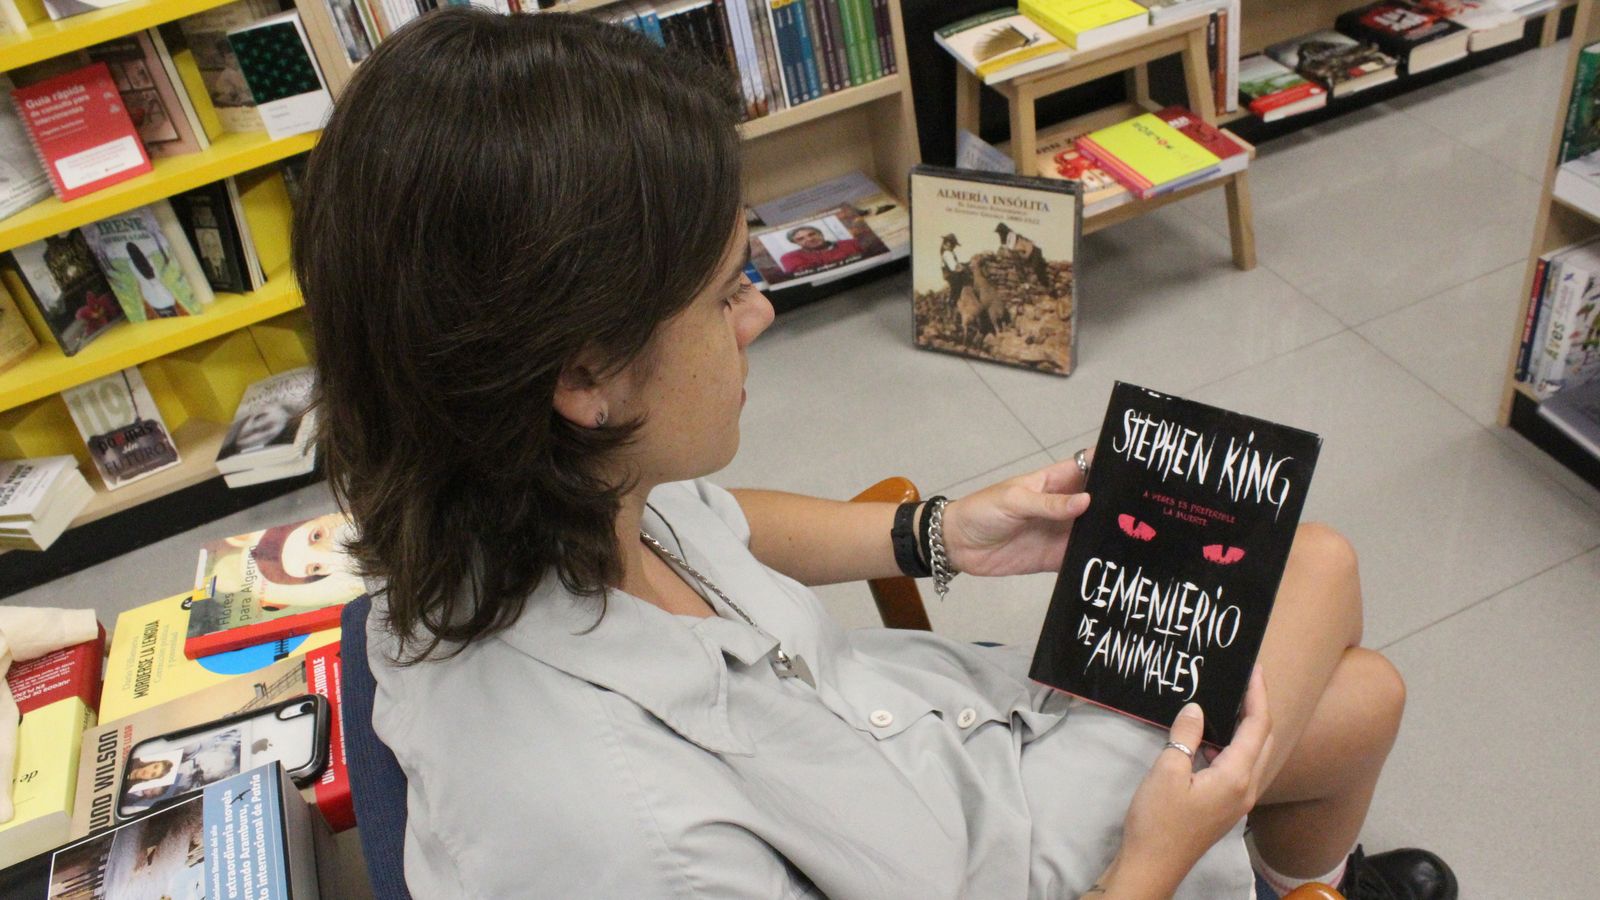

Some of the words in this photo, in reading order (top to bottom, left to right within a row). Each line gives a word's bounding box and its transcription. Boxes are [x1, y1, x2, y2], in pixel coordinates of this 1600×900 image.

[936, 188, 989, 204] ALMERÍA
[992, 194, 1051, 213] INSÓLITA
[1545, 321, 1565, 360] Aves
[105, 443, 165, 476] FUTURO
[121, 443, 139, 454] sin
[1113, 408, 1216, 485] STEPHEN
[1217, 430, 1295, 521] KING
[1163, 507, 1173, 516] LA
[1176, 511, 1208, 527] MUERTE
[1178, 501, 1188, 510] ES
[1190, 504, 1237, 524] PREFERIBLE
[219, 592, 235, 626] Flores
[240, 597, 252, 622] para
[1081, 557, 1241, 652] CEMENTERIO
[142, 619, 160, 648] LENGUA
[1077, 613, 1099, 646] DE
[140, 646, 155, 659] LA
[1083, 626, 1205, 702] ANIMALES
[133, 656, 153, 699] MORDERSE
[93, 729, 118, 793] WILSON
[250, 774, 262, 803] Patria
[89, 793, 113, 830] UND
[221, 789, 233, 823] novela
[251, 803, 263, 817] de
[237, 803, 251, 859] Aramburu,
[222, 823, 238, 899] extraordinaria
[252, 817, 269, 888] internacional
